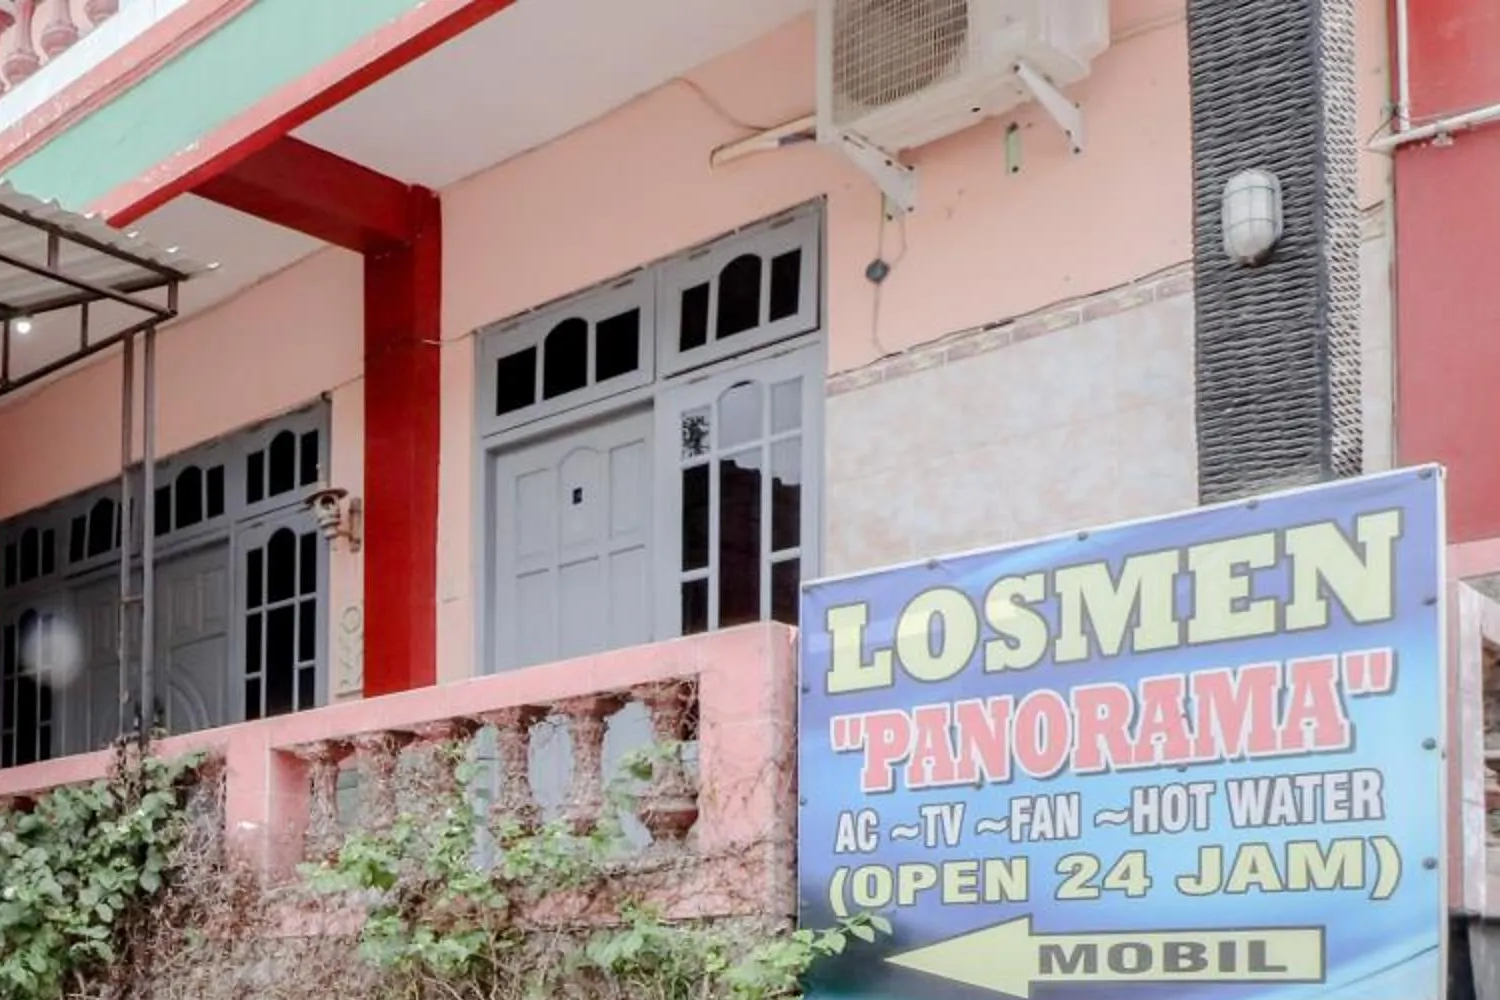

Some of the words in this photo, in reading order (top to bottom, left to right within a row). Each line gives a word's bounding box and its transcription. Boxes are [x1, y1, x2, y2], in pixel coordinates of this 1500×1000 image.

[825, 507, 1403, 695] LOSMEN
[830, 648, 1396, 793] "PANORAMA"
[835, 808, 879, 854] AC
[1228, 768, 1385, 828] WATER
[828, 856, 1029, 918] (OPEN
[1056, 850, 1153, 899] 24
[1176, 835, 1403, 900] JAM)
[1038, 939, 1289, 977] MOBIL
